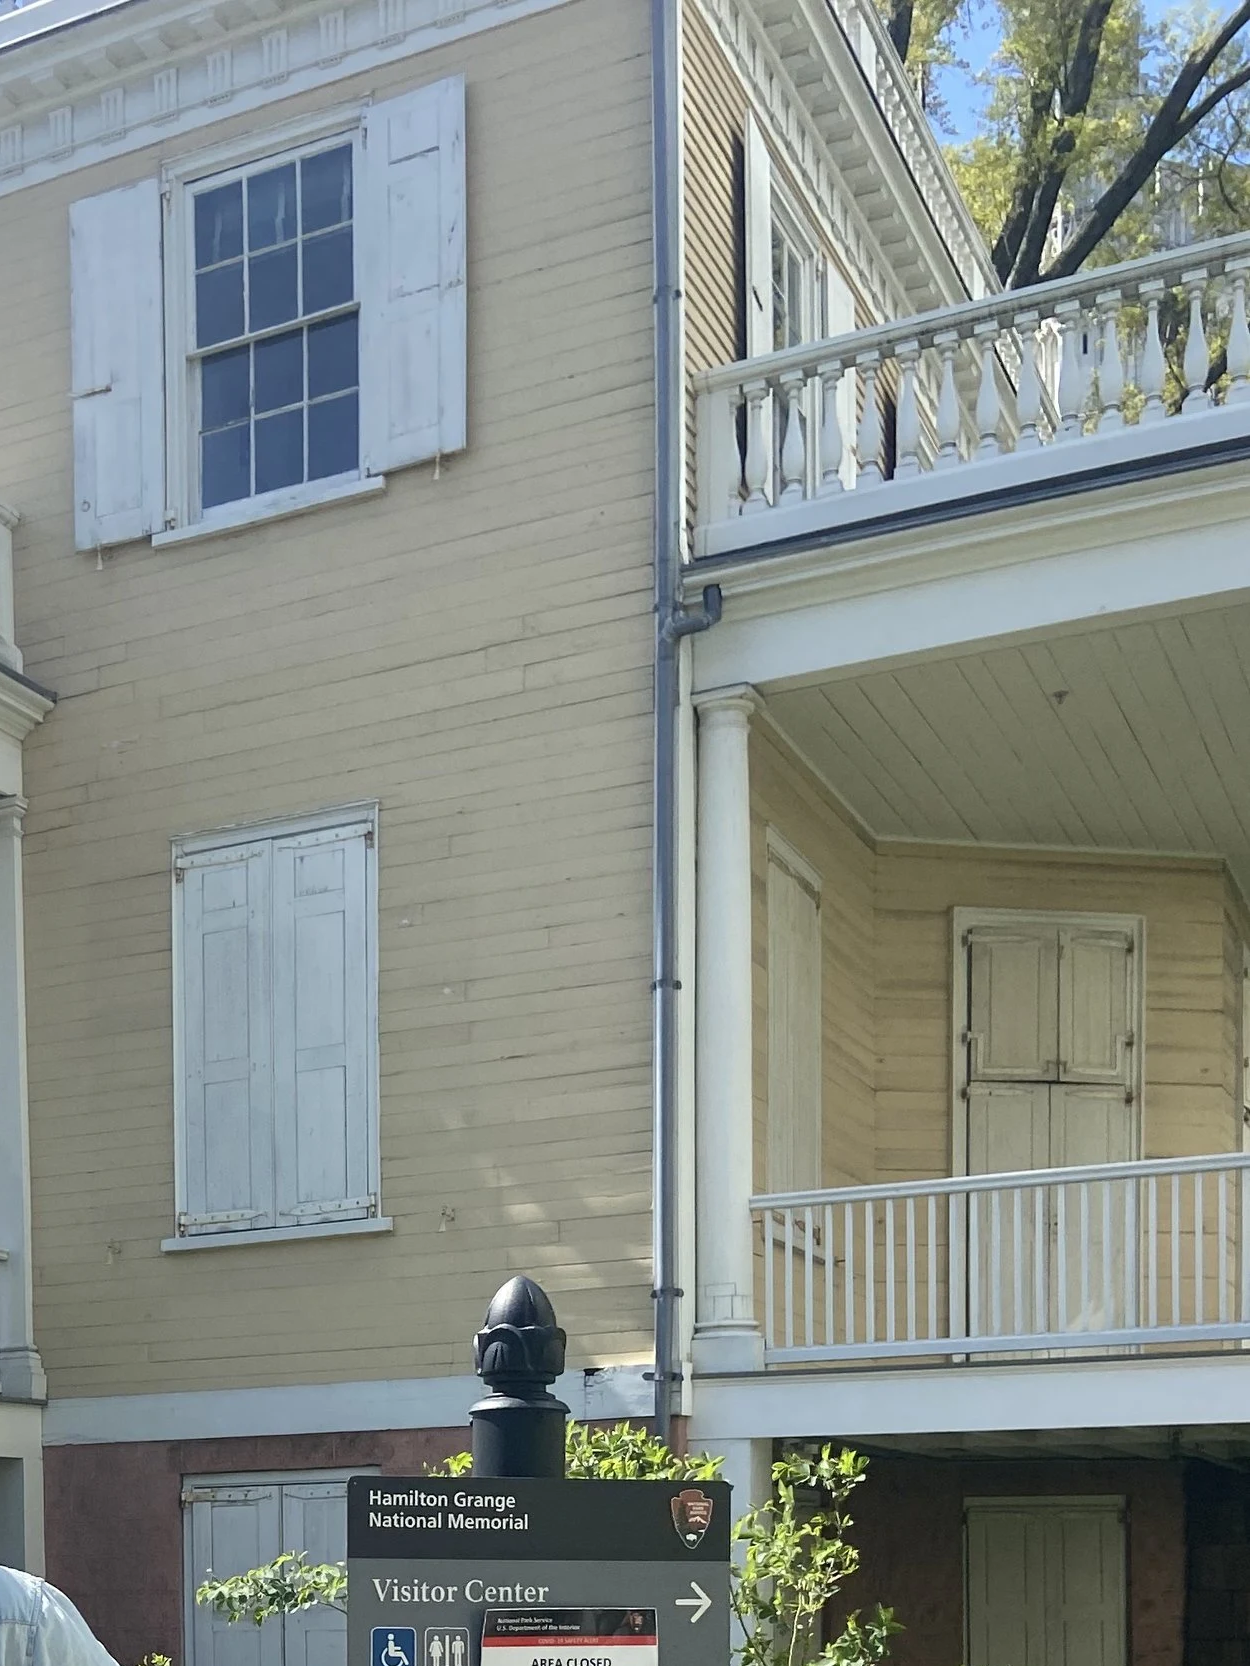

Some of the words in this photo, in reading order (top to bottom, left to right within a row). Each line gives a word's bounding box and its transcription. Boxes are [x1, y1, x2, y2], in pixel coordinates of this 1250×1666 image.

[368, 1490, 448, 1507] Hamilton
[453, 1491, 516, 1512] Grange
[368, 1511, 442, 1529] National
[447, 1513, 529, 1530] Memorial
[372, 1578, 459, 1602] Visitor
[464, 1579, 550, 1603] Center
